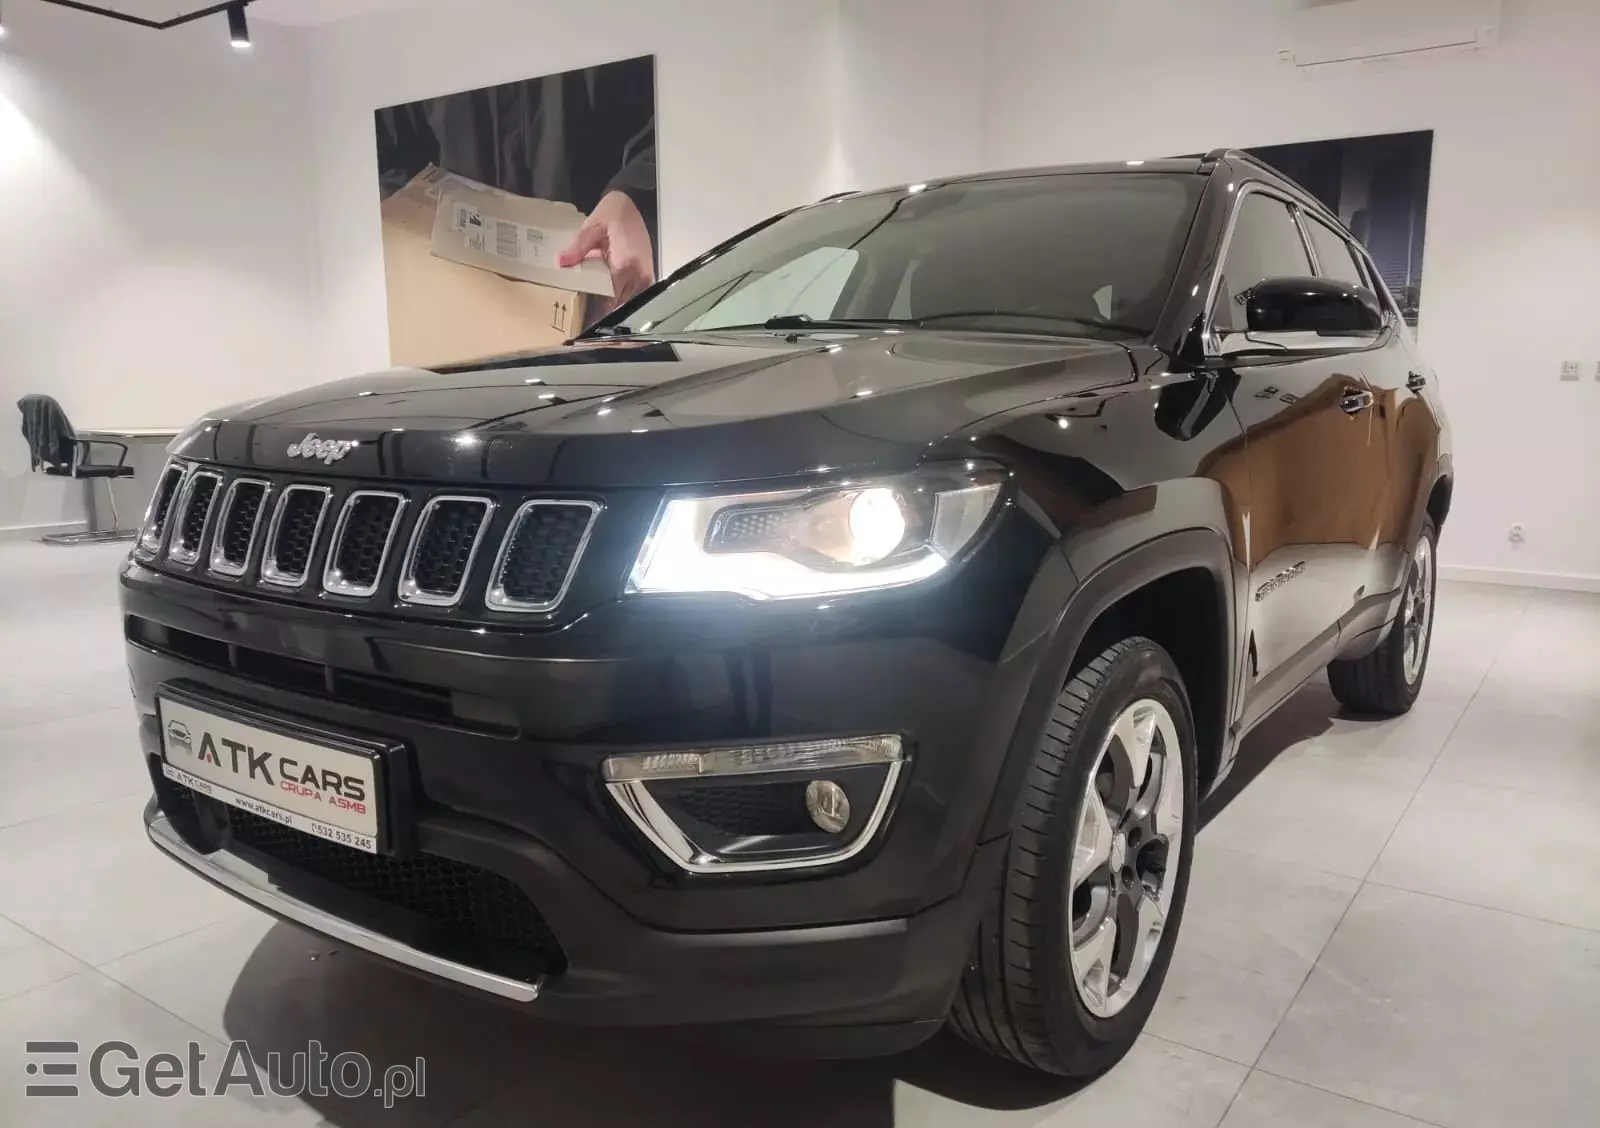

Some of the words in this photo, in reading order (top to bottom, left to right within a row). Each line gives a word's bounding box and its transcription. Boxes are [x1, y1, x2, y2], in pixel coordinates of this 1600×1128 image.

[286, 432, 351, 465] Jeep
[197, 731, 275, 786] ATK
[279, 757, 365, 802] CARS
[235, 797, 293, 825] www.atkcars.pl
[329, 796, 366, 814] ASMB
[317, 824, 333, 839] 532
[335, 830, 352, 844] 535
[355, 836, 372, 850] 245
